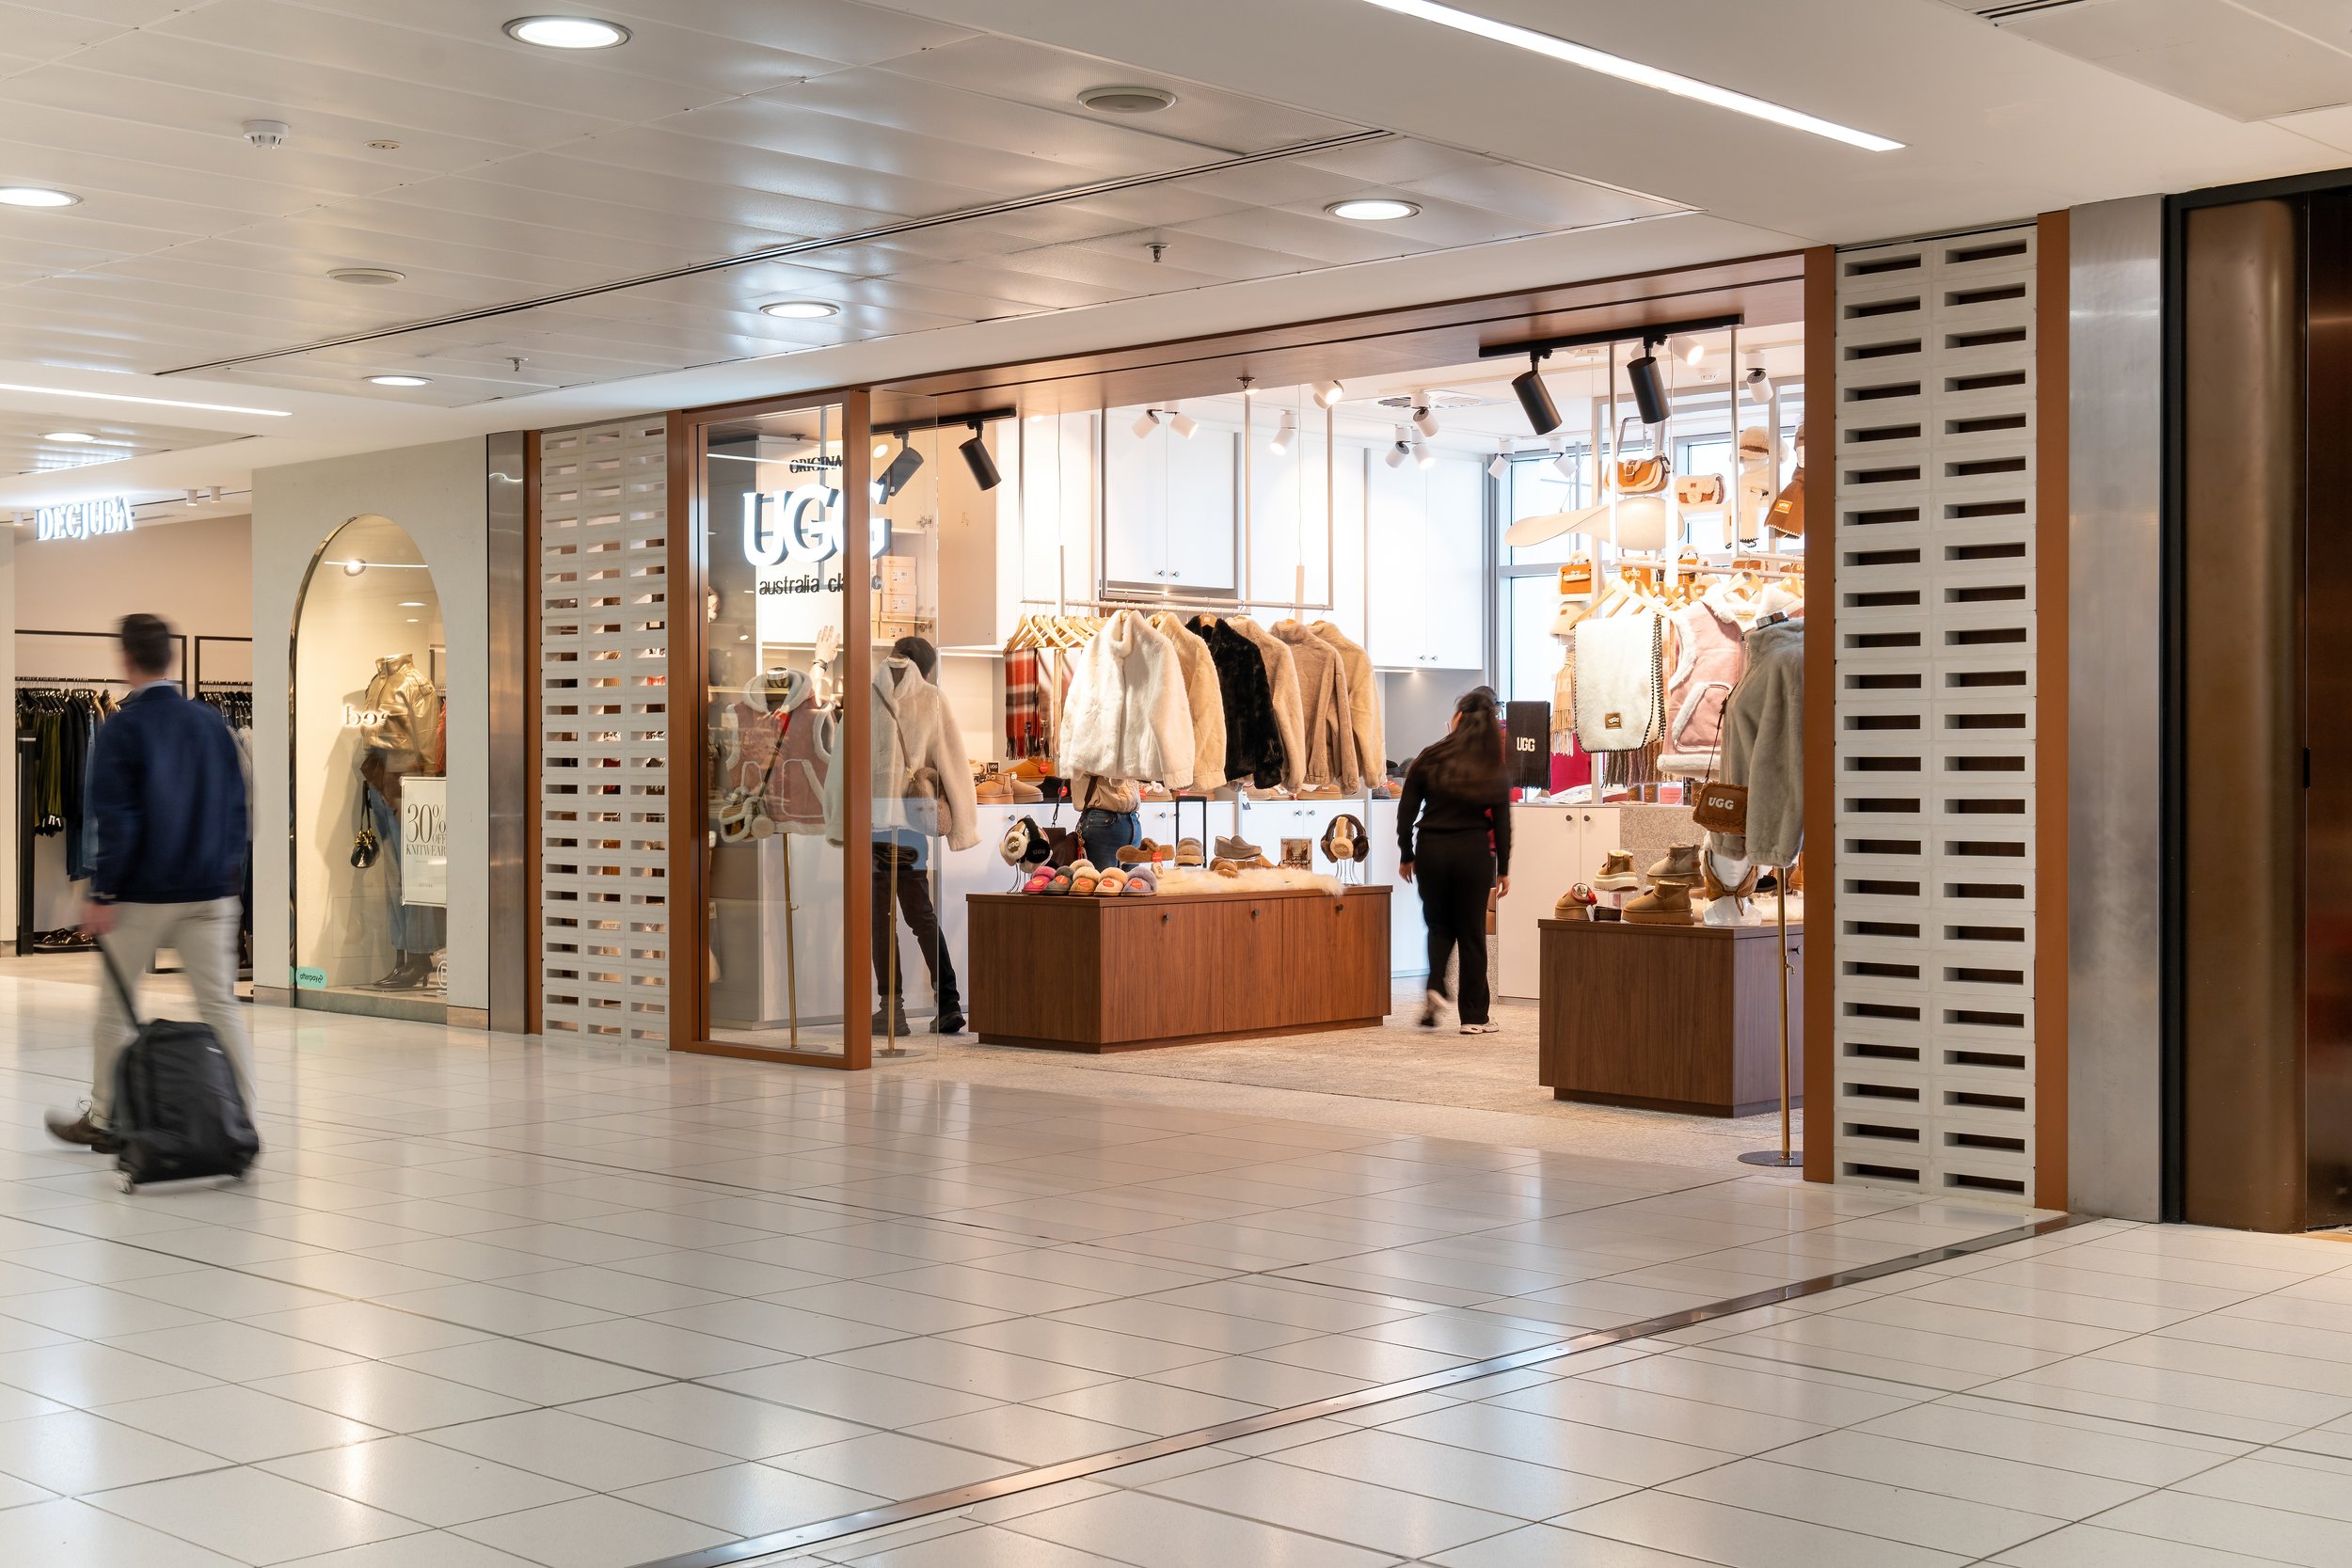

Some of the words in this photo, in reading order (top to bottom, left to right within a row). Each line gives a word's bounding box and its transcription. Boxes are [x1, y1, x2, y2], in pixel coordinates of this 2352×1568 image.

[789, 455, 843, 473] ORIGINA
[36, 497, 134, 541] DECJUBA
[759, 575, 819, 594] australia
[1517, 736, 1535, 752] UGG
[1708, 797, 1735, 810] UGG
[406, 803, 446, 843] 30%
[433, 833, 446, 845] OFF
